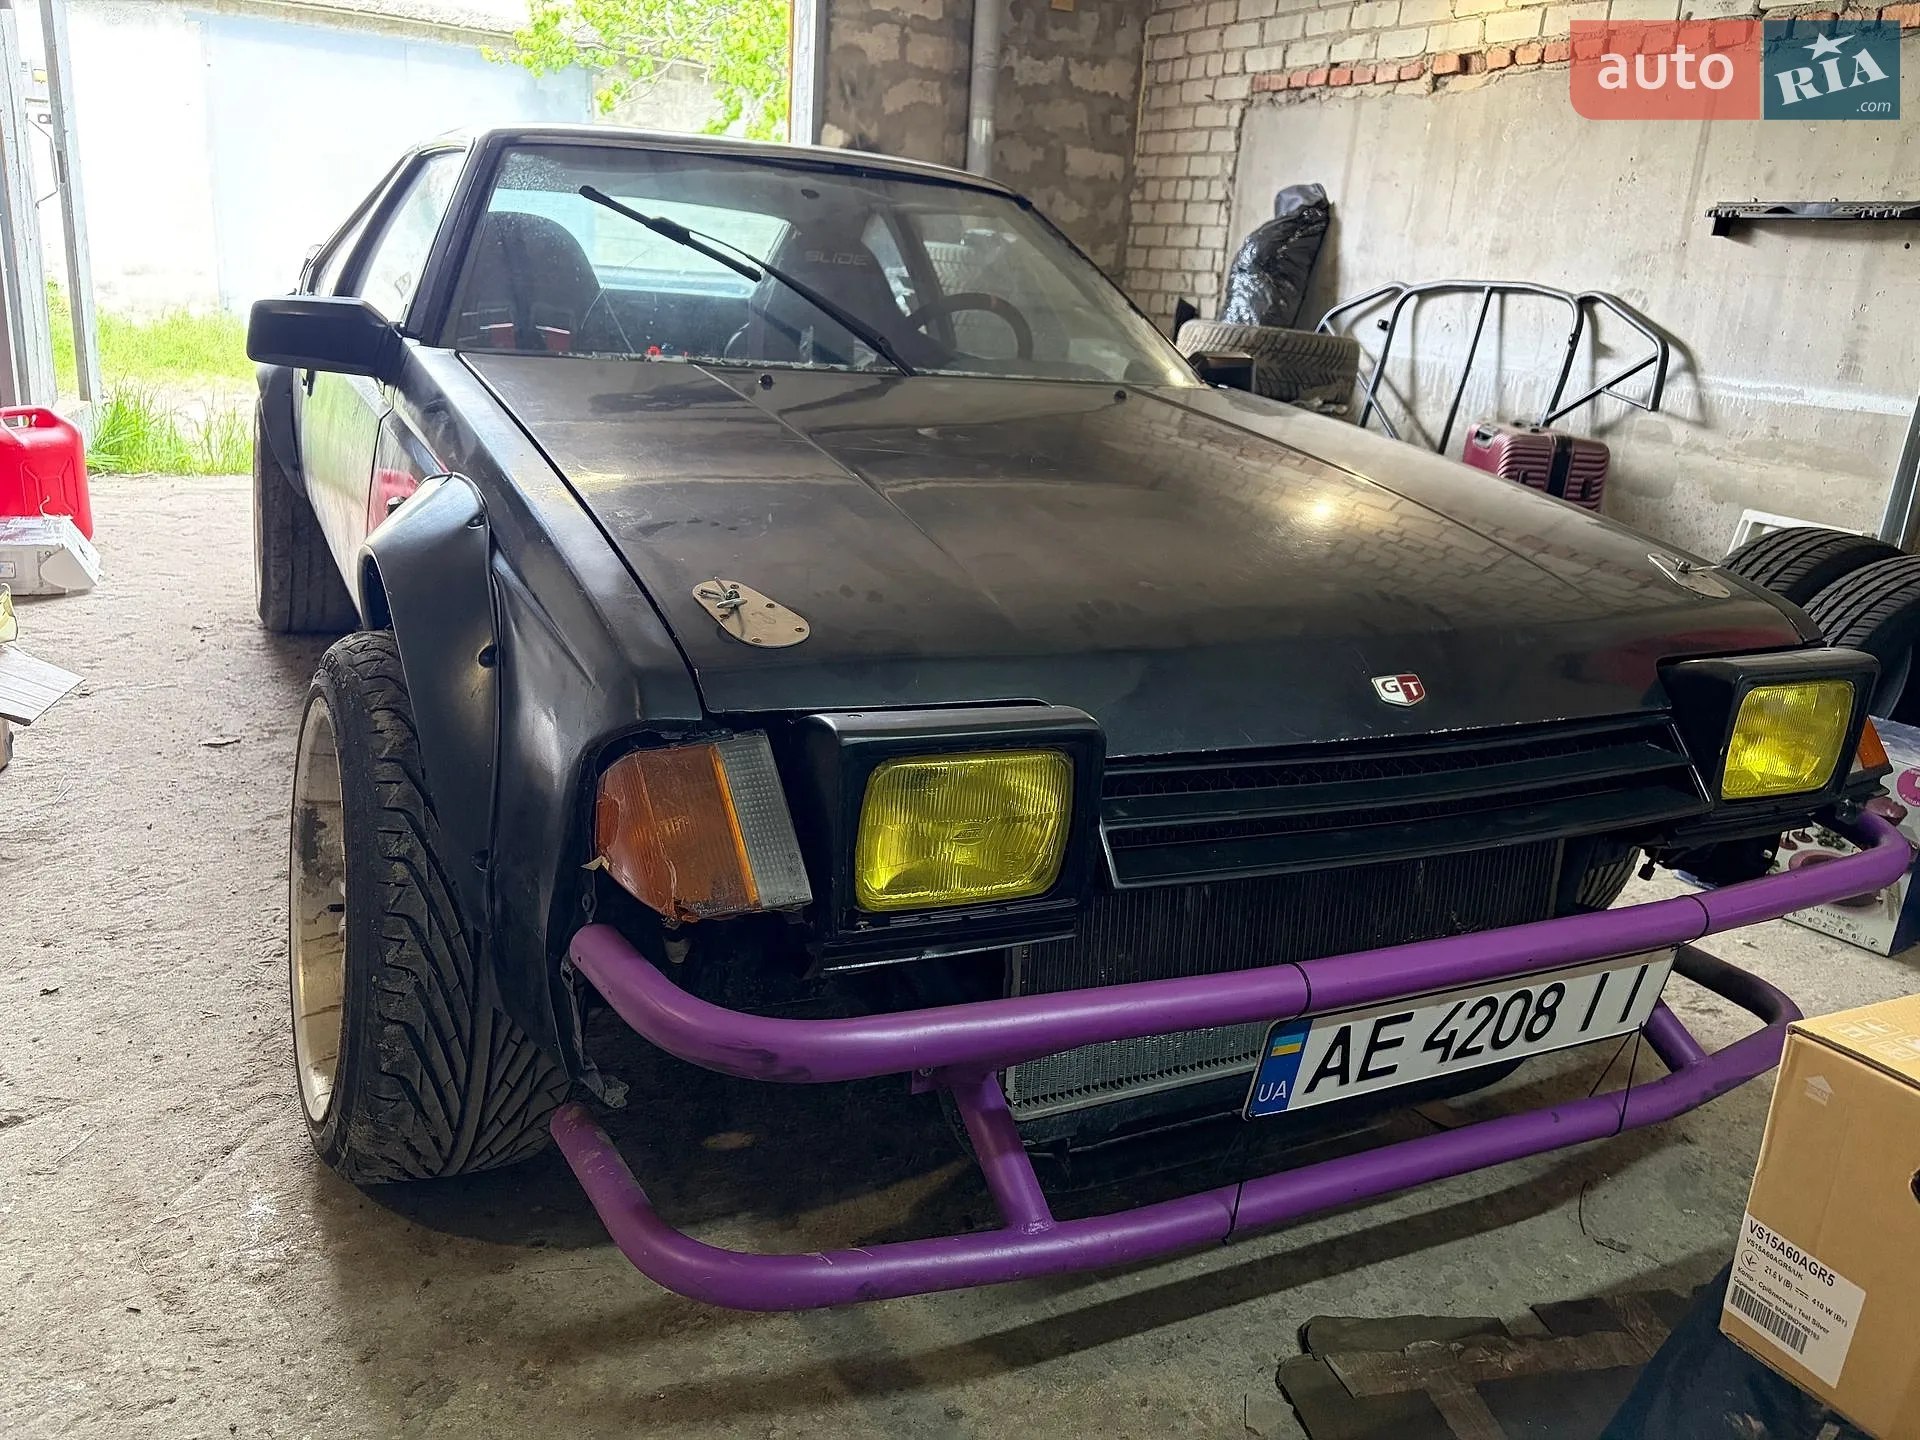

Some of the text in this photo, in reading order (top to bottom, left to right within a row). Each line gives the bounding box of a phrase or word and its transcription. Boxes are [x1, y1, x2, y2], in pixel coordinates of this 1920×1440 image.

[1381, 679, 1419, 697] GT
[1302, 1011, 1415, 1094] AE
[1420, 981, 1567, 1065] 4208
[1257, 1079, 1289, 1102] UA
[1749, 1219, 1836, 1287] VS15A60AGR5
